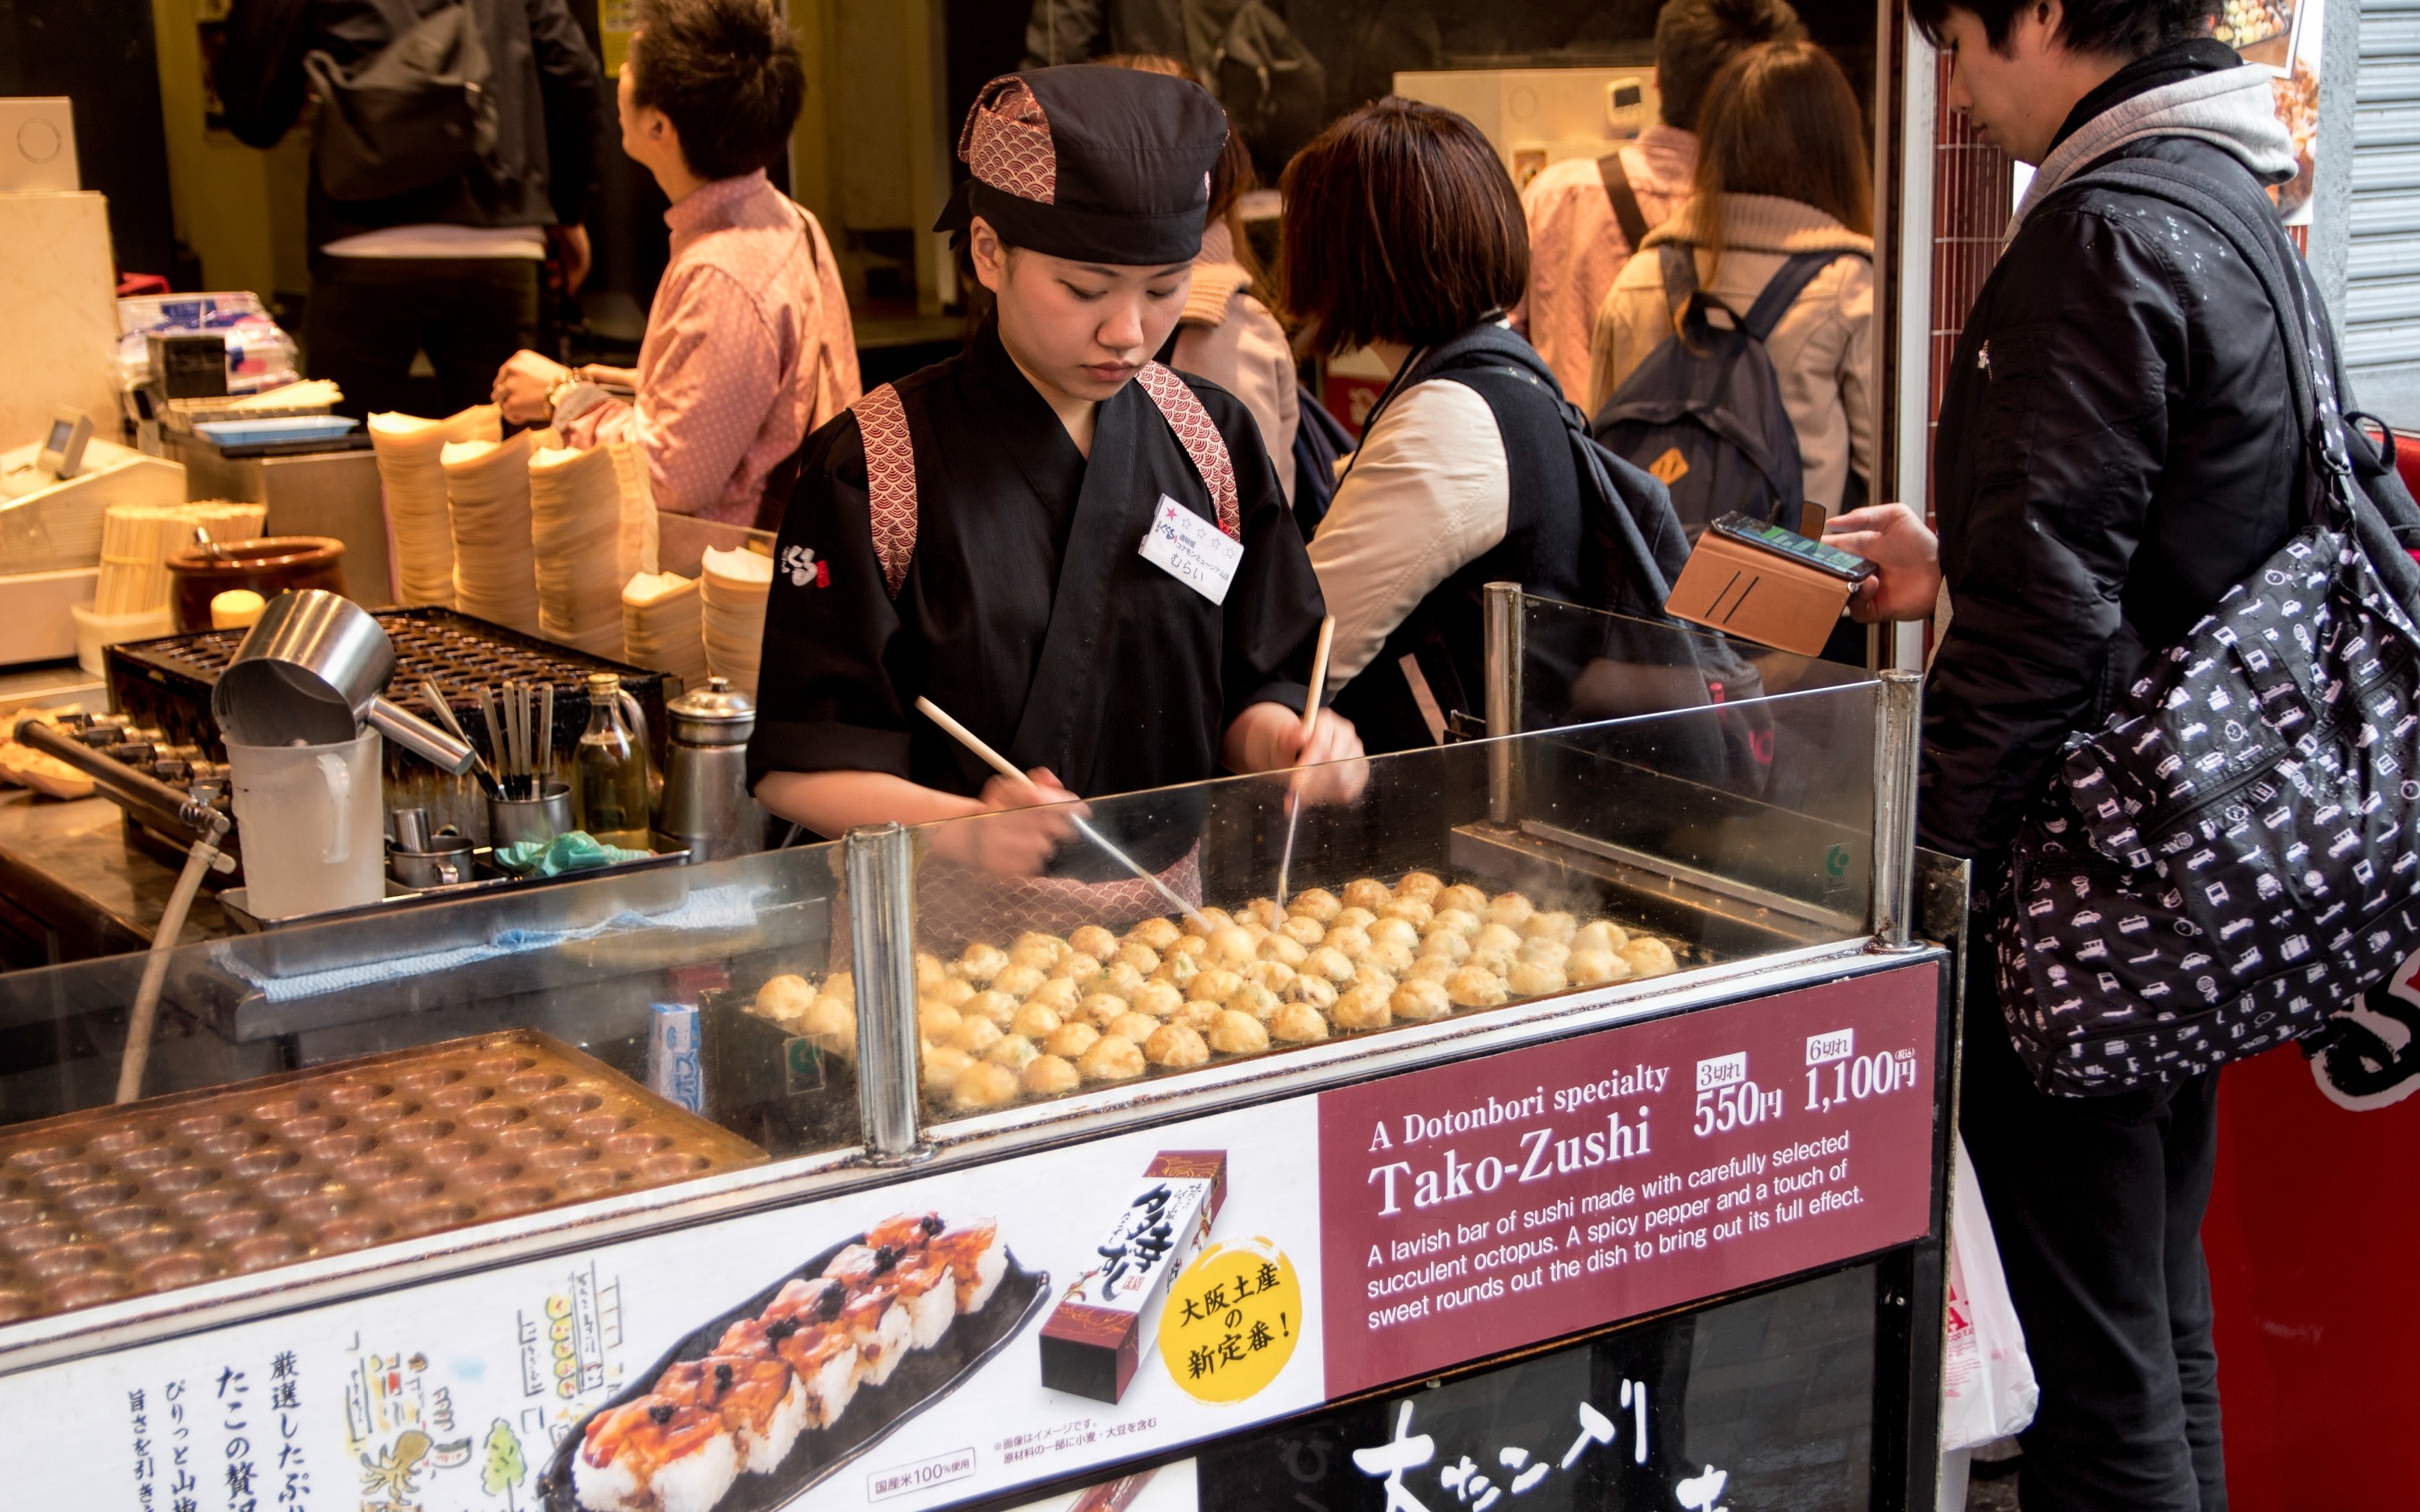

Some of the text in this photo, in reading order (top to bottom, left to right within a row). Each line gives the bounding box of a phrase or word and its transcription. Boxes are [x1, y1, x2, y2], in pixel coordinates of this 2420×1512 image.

[1170, 553, 1204, 581] むらい
[1700, 1061, 1742, 1086] 3切れ
[1805, 1051, 1916, 1113] 1,100円
[1810, 1039, 1848, 1060] 6切れ
[1368, 1064, 1670, 1152] A Dotonbori specialty
[1693, 1081, 1783, 1136] 550円
[1367, 1106, 1651, 1216] Tako-Zushi
[1367, 1130, 1850, 1267] A lavish bar of sushi made with carefully selected
[1367, 1158, 1848, 1298] succulent octopus. A spicy pepper and a touch of
[1368, 1185, 1864, 1330] sweet rounds out the dish to bring out its full effect.
[1179, 1263, 1281, 1328] 大阪土産
[1225, 1309, 1243, 1329] の
[1187, 1311, 1290, 1381] 新定番！
[128, 1389, 155, 1512] 旨さを引き
[875, 1458, 970, 1495] 国産米100%使用
